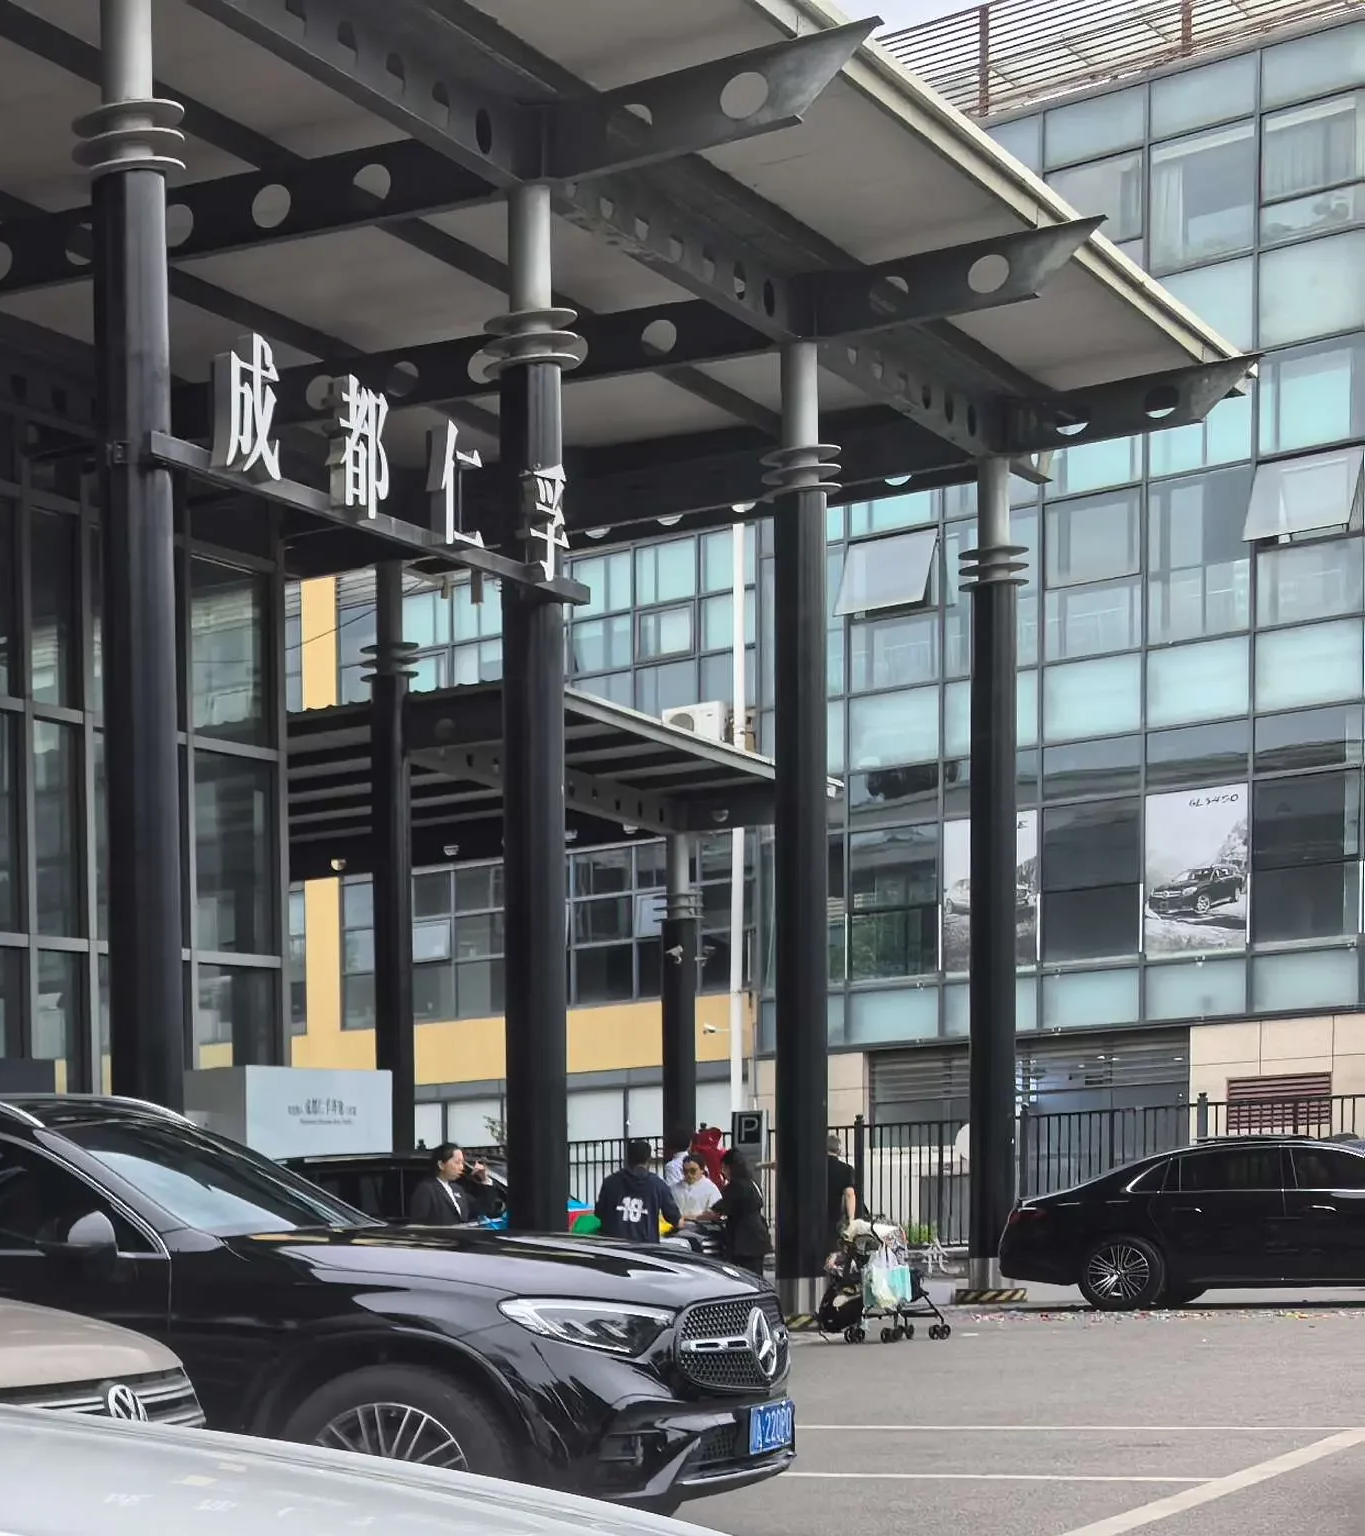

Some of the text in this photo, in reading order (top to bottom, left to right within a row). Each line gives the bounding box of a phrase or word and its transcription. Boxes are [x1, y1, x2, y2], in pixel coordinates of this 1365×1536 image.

[225, 332, 570, 581] 成都仁孚
[740, 1116, 759, 1142] P
